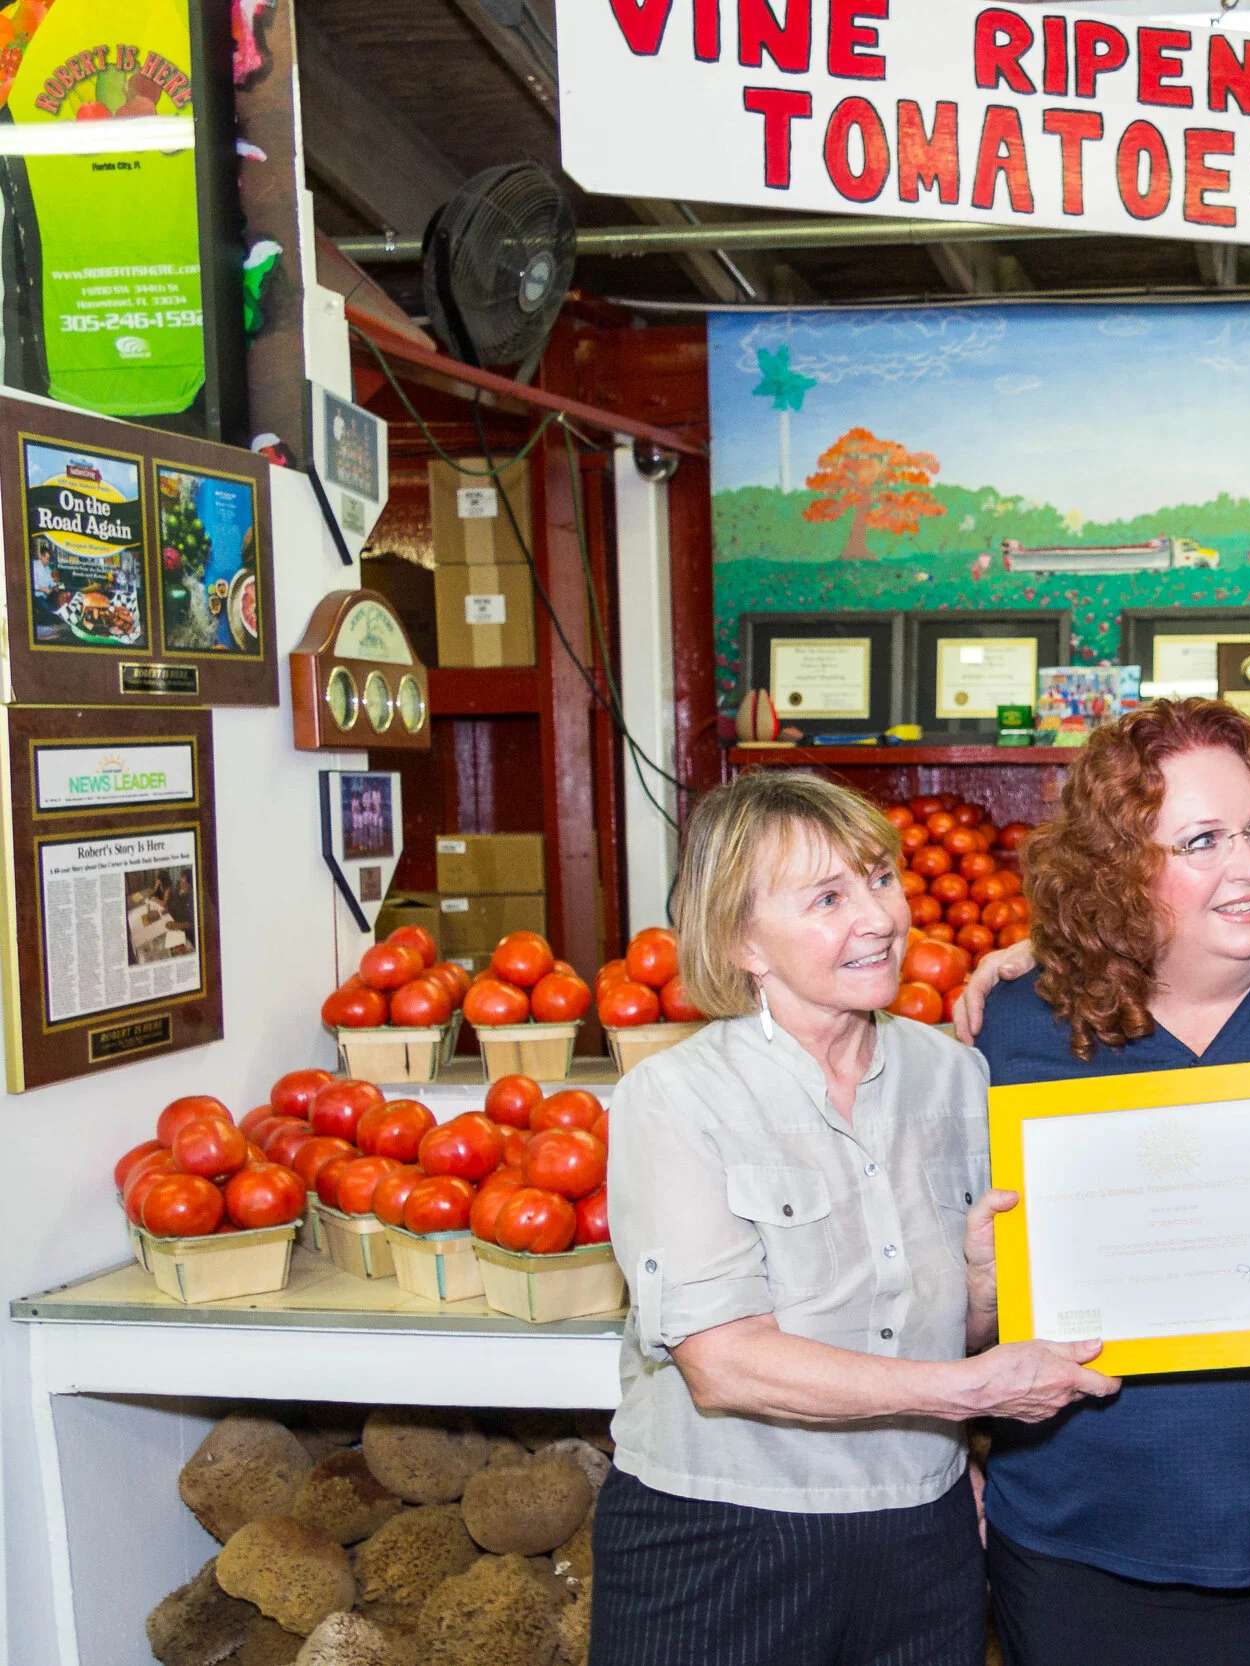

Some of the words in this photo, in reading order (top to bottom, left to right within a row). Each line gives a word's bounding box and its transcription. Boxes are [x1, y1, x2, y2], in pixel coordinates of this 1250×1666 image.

[609, 0, 889, 80] VINE
[35, 45, 108, 115] ROBERT
[117, 44, 137, 70] IS
[141, 50, 194, 110] HERE
[59, 490, 85, 511] On
[86, 494, 110, 516] the
[37, 507, 82, 533] Road
[86, 517, 131, 540] Again
[68, 775, 111, 794] NEWS
[114, 772, 168, 791] LEADER
[77, 844, 112, 860] Robert's
[114, 844, 135, 856] Story
[138, 841, 144, 853] Is
[147, 840, 165, 851] Here
